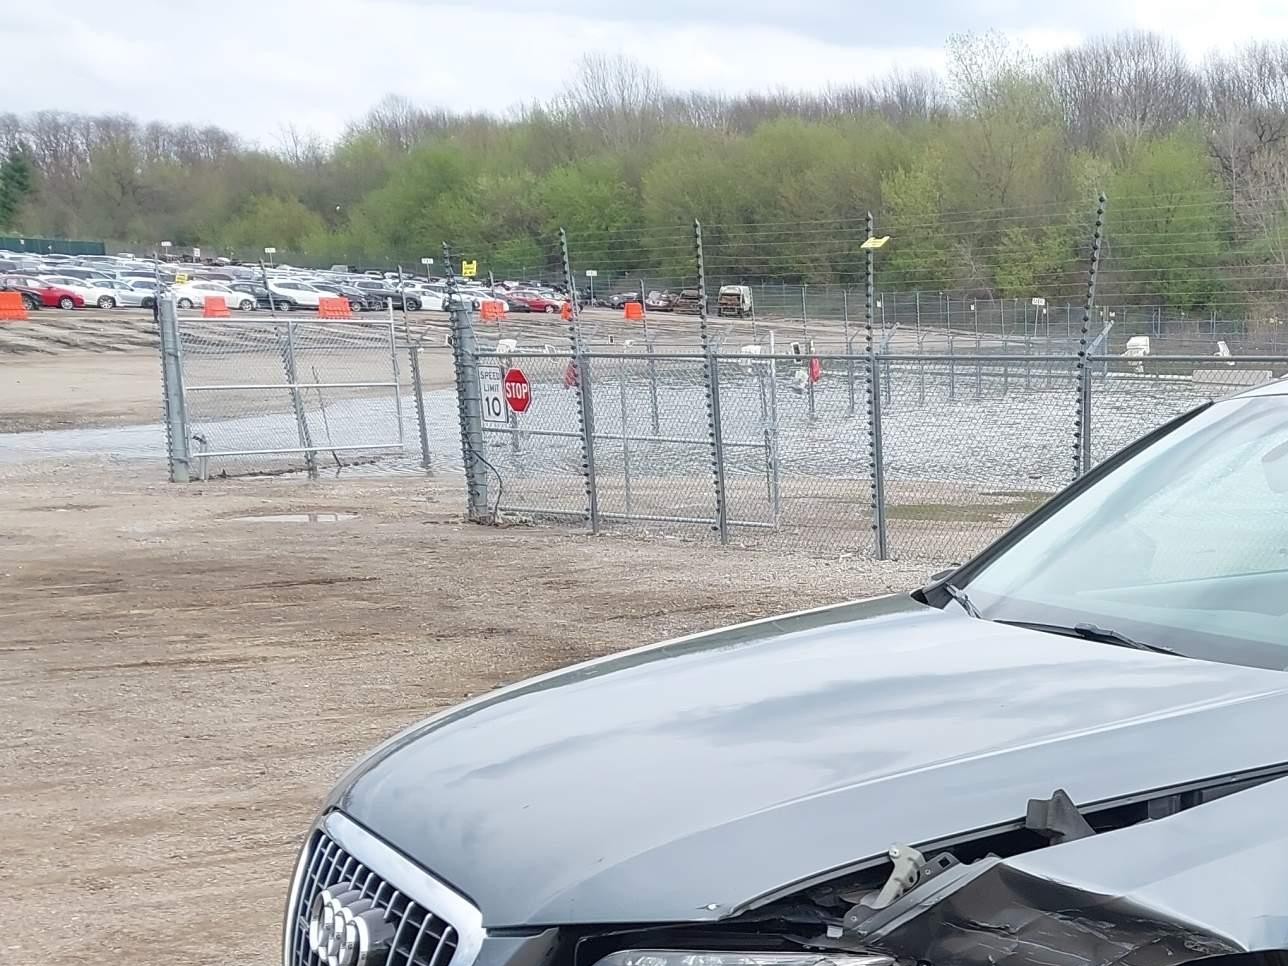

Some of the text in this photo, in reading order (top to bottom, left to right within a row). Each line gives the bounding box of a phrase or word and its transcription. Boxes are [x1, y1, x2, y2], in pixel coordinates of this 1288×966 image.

[481, 371, 500, 380] SPEED
[483, 383, 499, 392] LIMIT
[506, 382, 528, 399] STOP
[485, 396, 501, 417] 10
